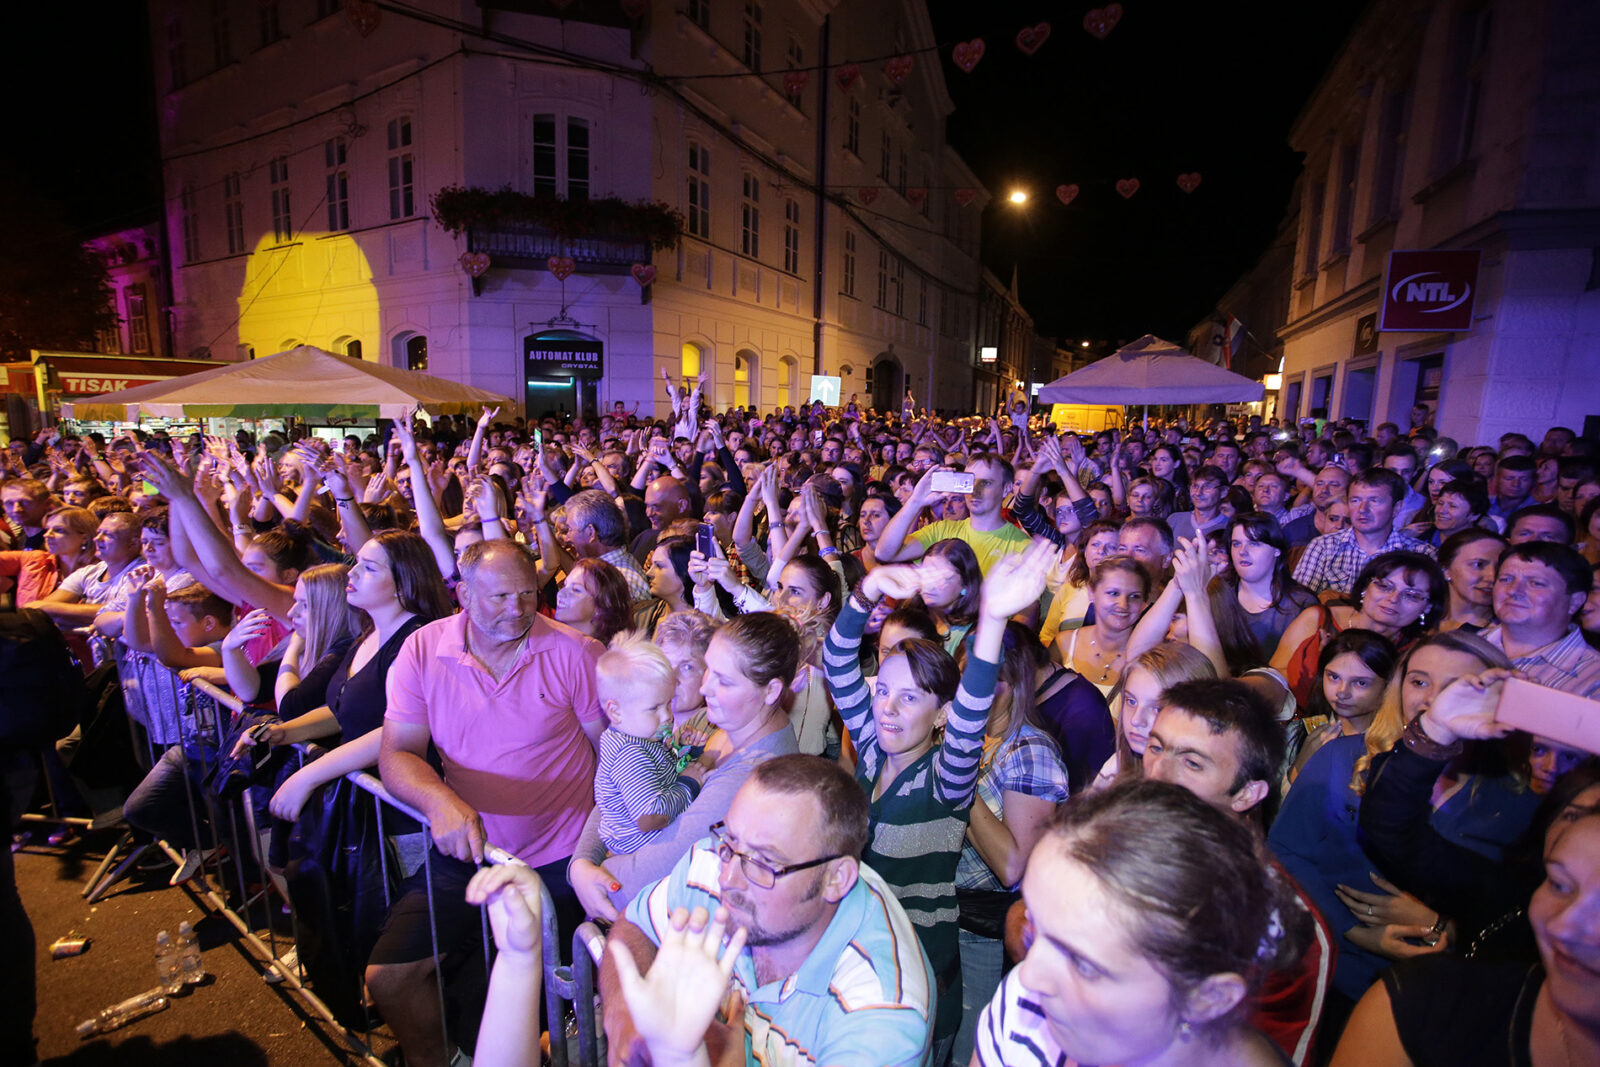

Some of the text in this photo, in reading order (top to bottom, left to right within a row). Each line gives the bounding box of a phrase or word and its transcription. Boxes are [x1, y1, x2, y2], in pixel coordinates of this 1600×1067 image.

[1406, 282, 1456, 302] NTL
[529, 350, 599, 362] AUTOMAT KLUB
[66, 378, 129, 393] TISAK
